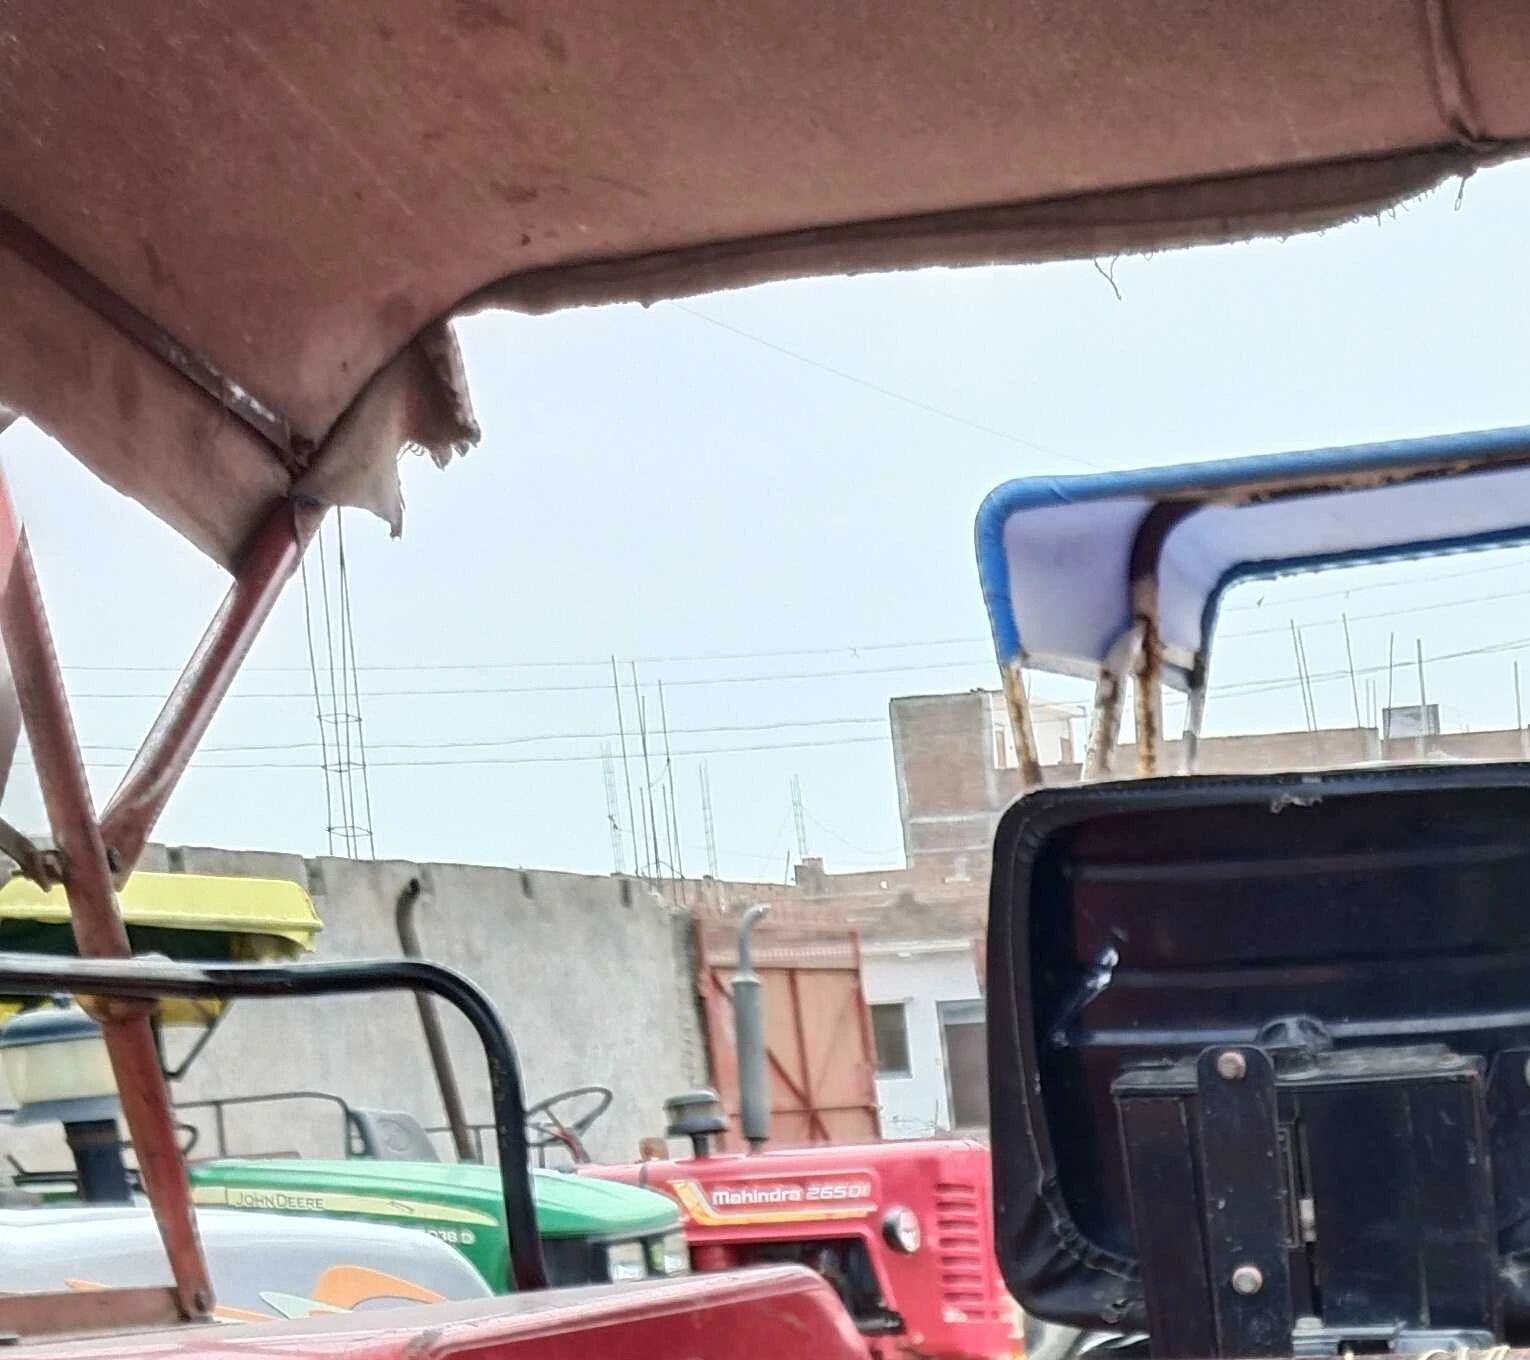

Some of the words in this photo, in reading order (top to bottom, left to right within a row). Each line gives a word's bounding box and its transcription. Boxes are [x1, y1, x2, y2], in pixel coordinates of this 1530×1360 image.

[235, 1190, 274, 1208] JOHN
[275, 1193, 325, 1210] DEERE
[712, 1187, 801, 1206] Mahindra
